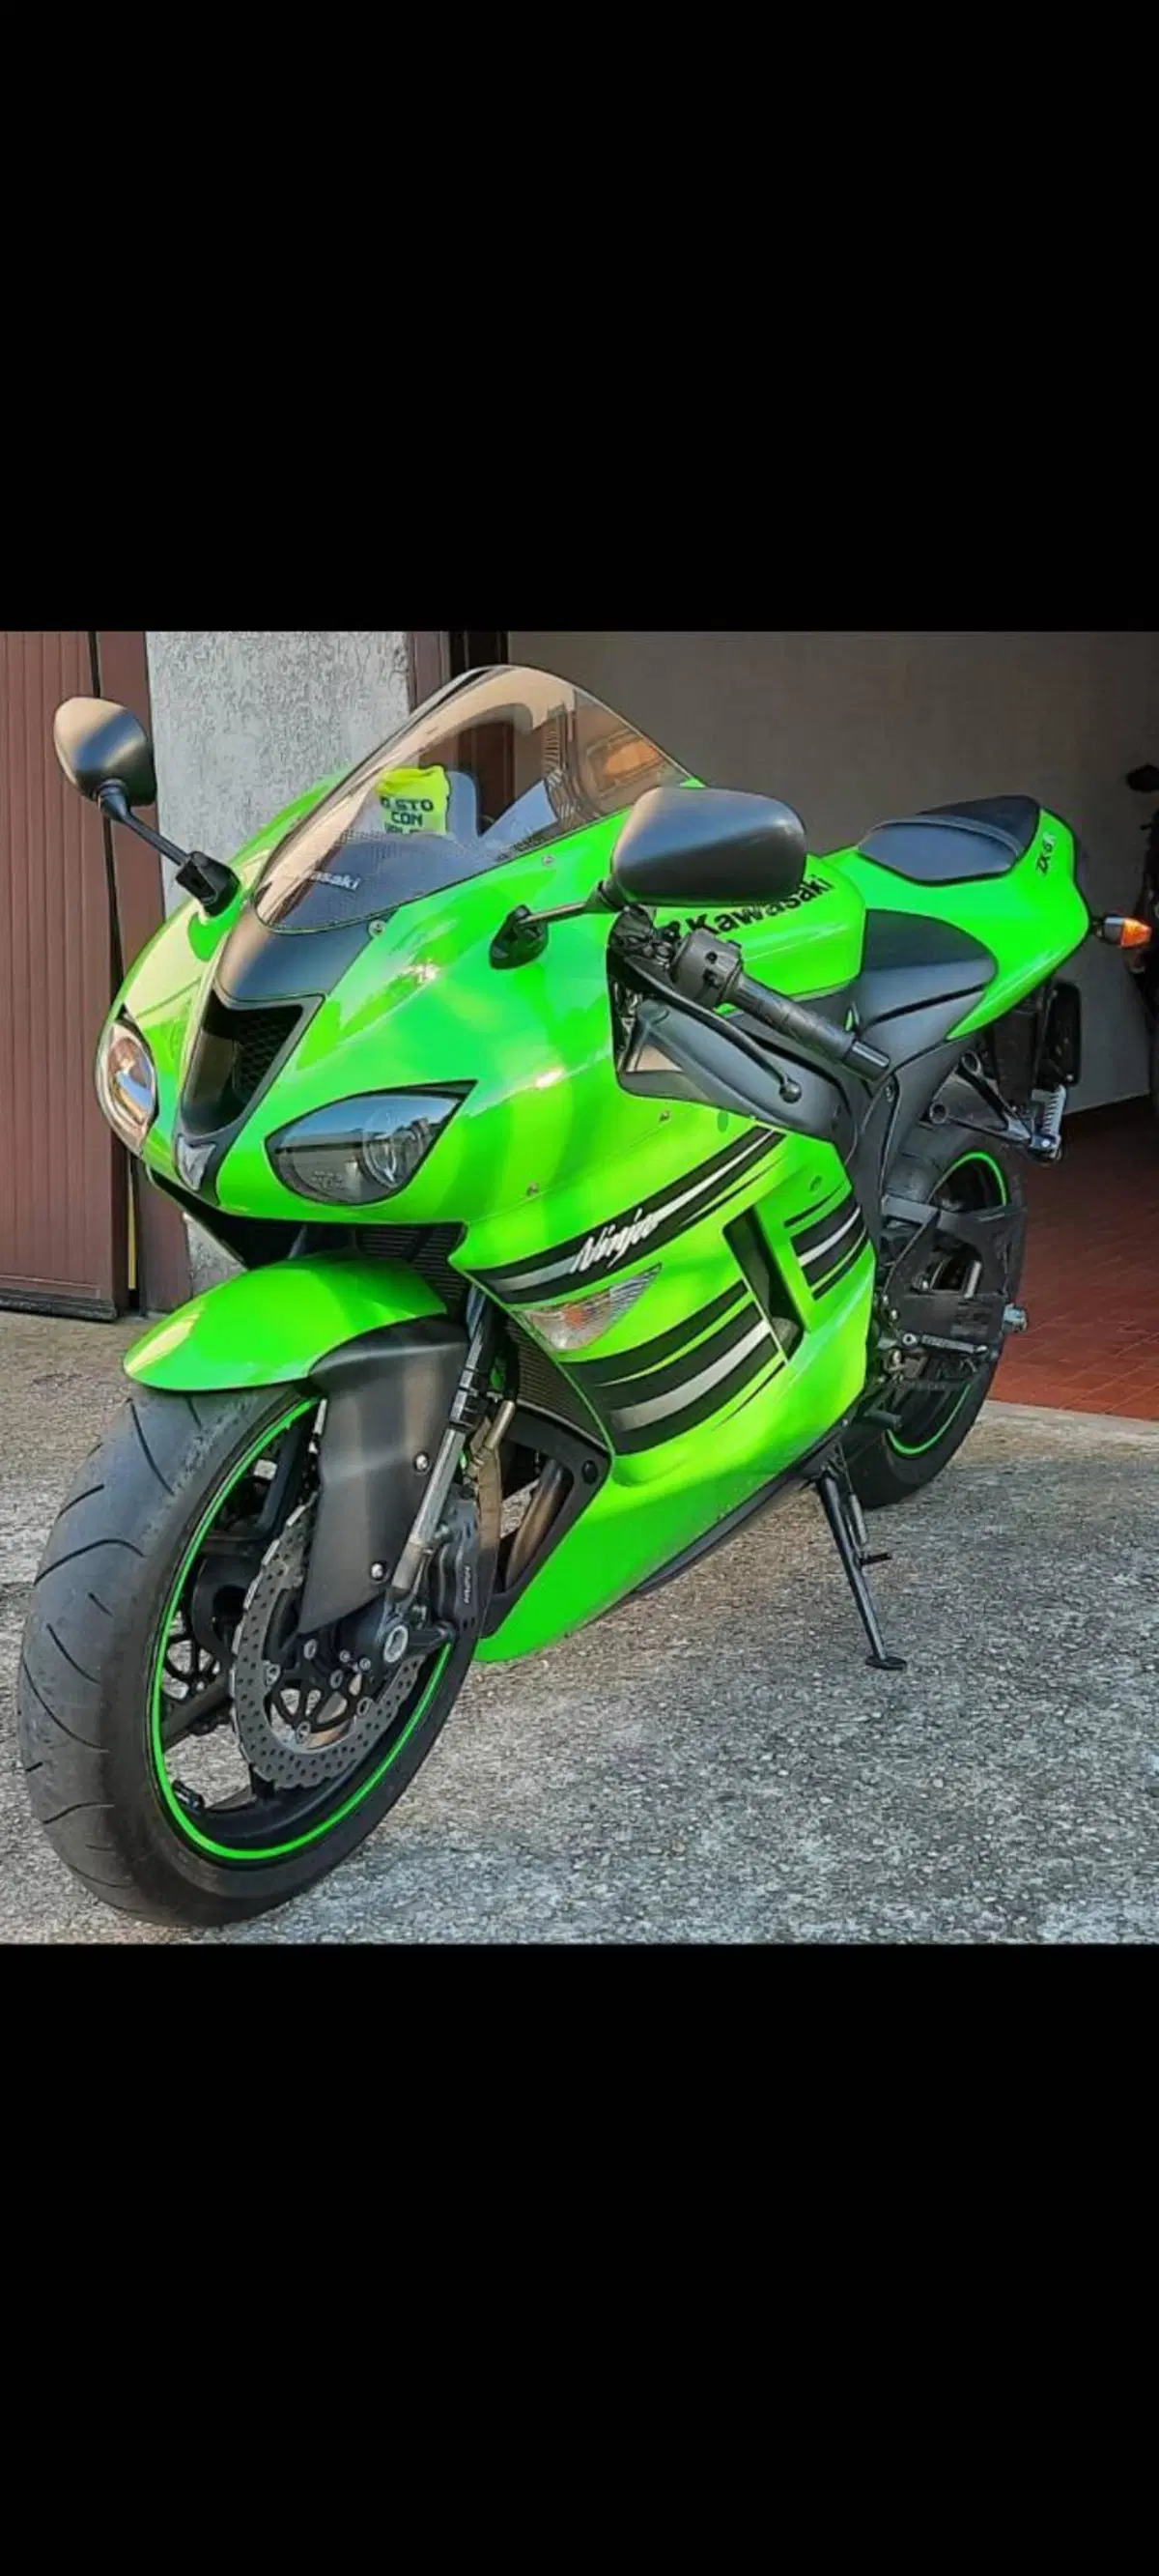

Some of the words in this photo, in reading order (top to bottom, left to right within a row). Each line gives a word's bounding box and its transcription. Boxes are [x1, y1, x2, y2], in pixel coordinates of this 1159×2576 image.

[391, 812, 423, 827] CON
[685, 873, 834, 934] Kawasaki
[569, 1207, 659, 1274] Ninja
